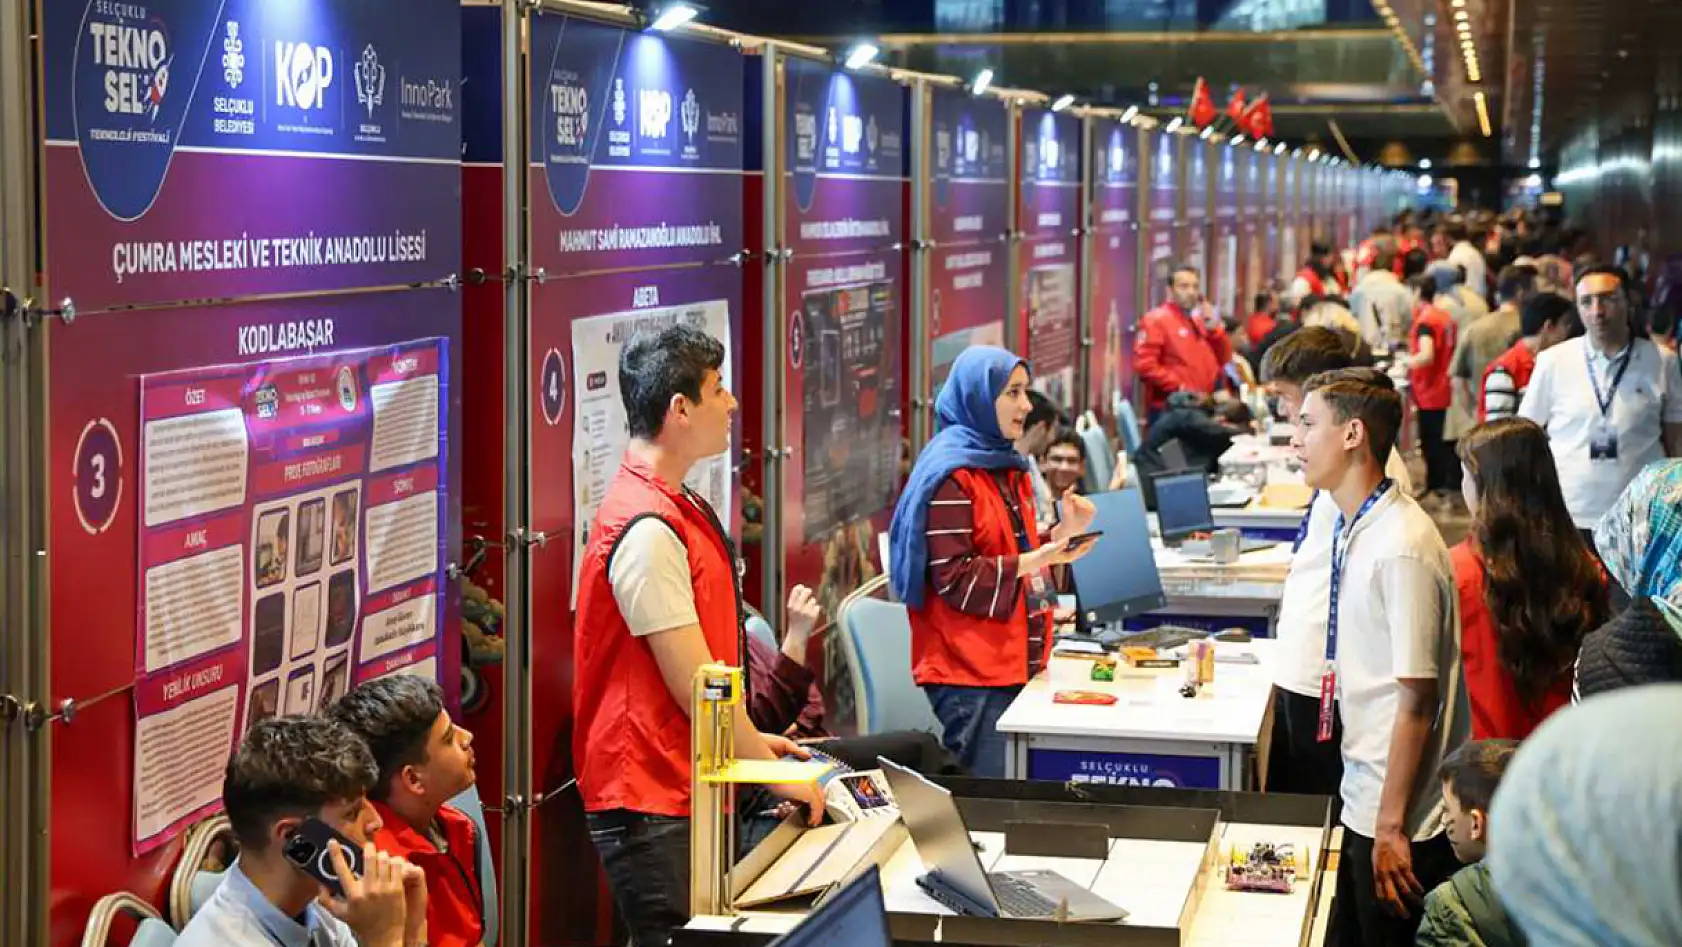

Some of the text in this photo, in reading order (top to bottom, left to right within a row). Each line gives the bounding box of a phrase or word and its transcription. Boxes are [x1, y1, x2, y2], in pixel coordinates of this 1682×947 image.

[90, 19, 167, 71] TEKNO
[104, 70, 145, 114] SEL
[275, 40, 333, 110] KOP
[214, 97, 254, 116] SELÇUKLU
[401, 76, 453, 110] InnoPark
[550, 81, 588, 114] TEKNO
[113, 230, 426, 283] ÇUMRA MESLEKİ VE TEKNİK ANADOLU LİSESİ
[560, 229, 597, 252] MAHMUT
[239, 319, 334, 355] KODLABAŞAR
[549, 370, 558, 402] 4
[90, 453, 106, 499] 3
[1081, 761, 1149, 774] SELÇUKLU
